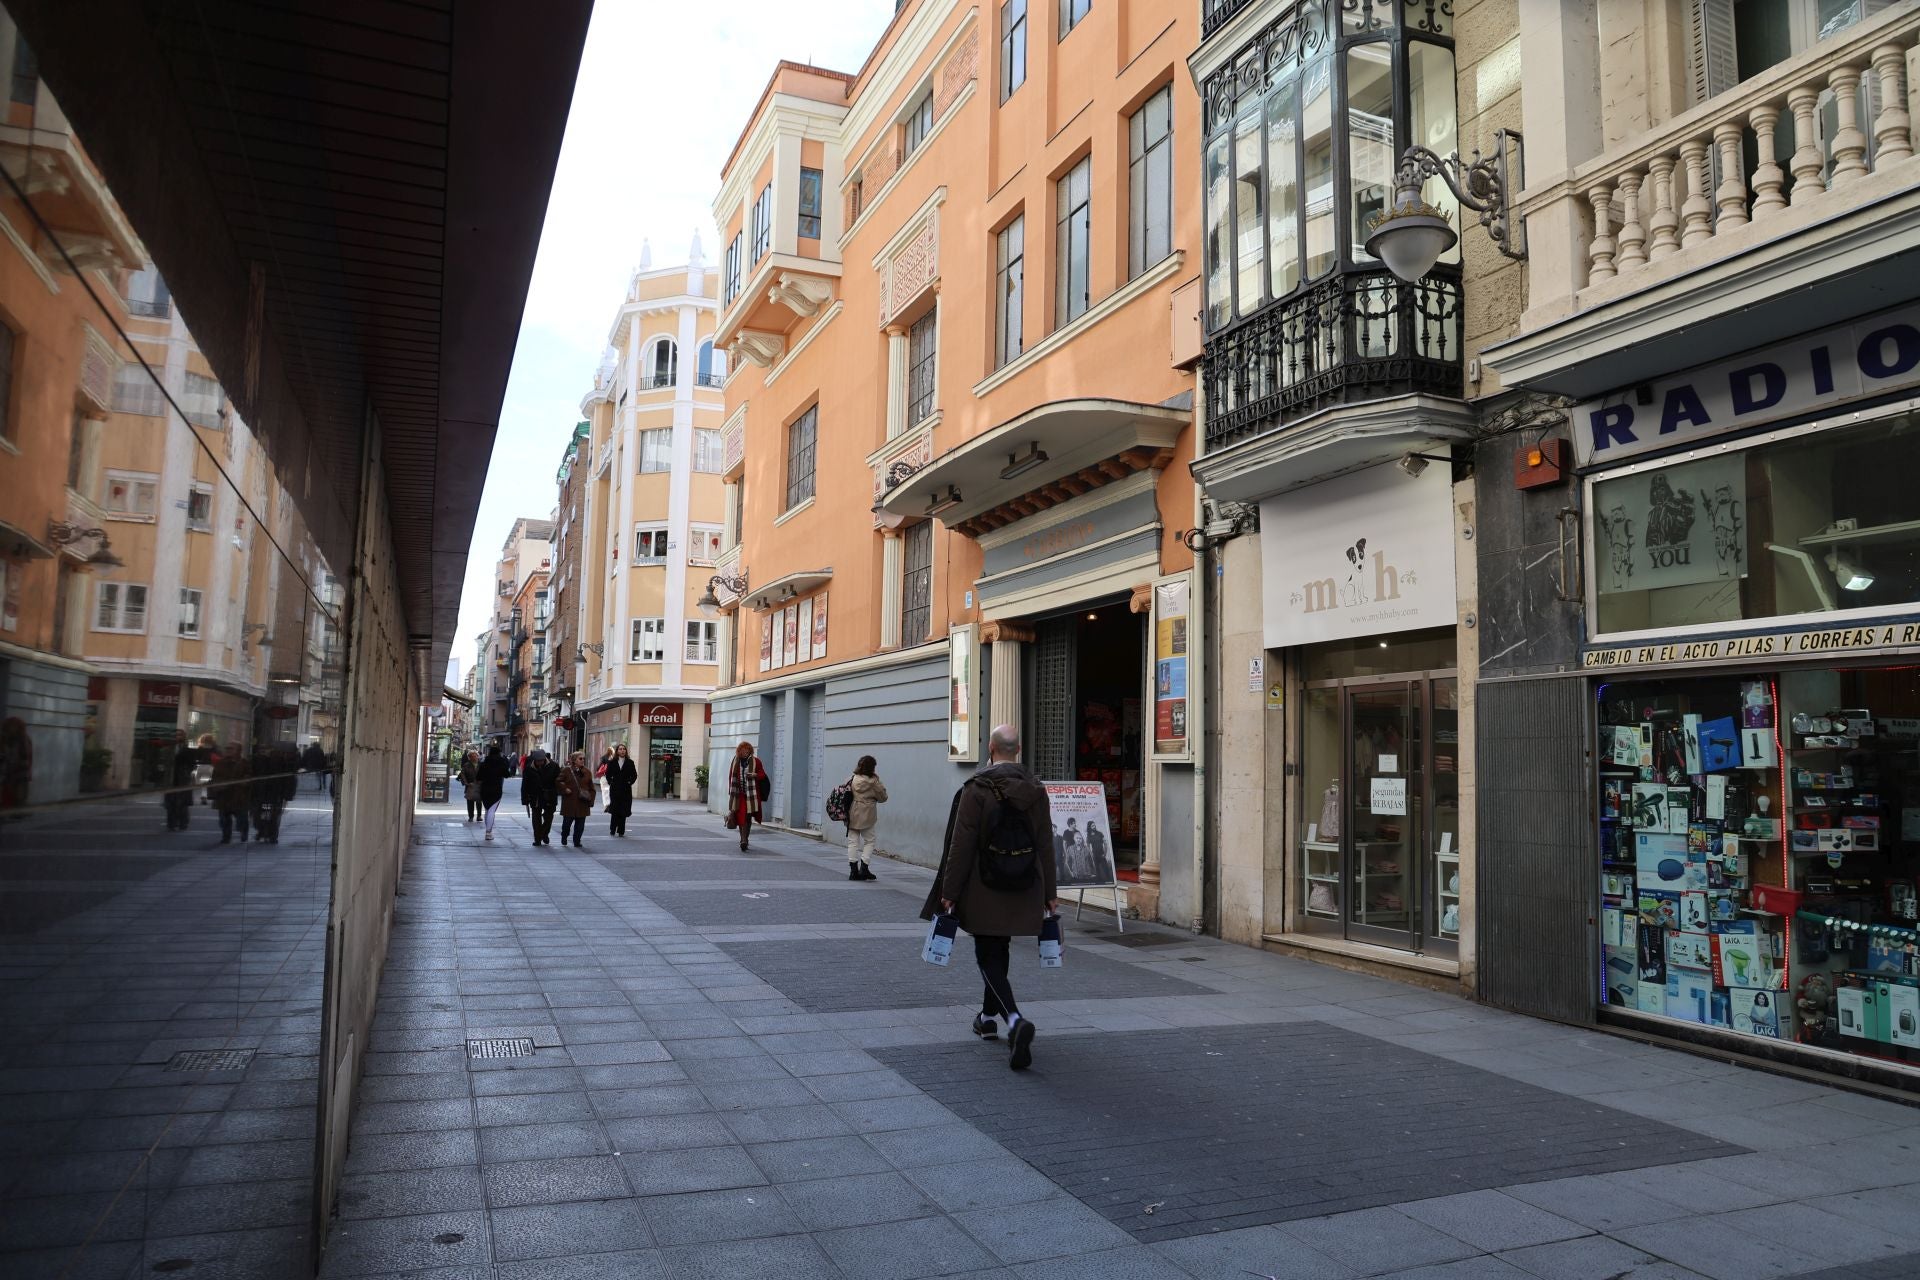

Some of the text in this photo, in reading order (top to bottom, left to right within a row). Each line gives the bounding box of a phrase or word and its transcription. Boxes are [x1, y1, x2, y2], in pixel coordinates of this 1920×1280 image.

[1590, 324, 1920, 450] RADIO
[1649, 546, 1691, 569] YOU
[1586, 650, 1631, 665] CAMBIO
[1638, 648, 1655, 662] EN
[1660, 647, 1675, 661] EL
[1683, 642, 1719, 660] ACTO
[1726, 637, 1774, 656] PILAS
[1783, 635, 1793, 651] Y
[1800, 628, 1875, 650] CORREAS
[1882, 627, 1893, 644] A
[642, 712, 677, 723] arenal
[1046, 785, 1099, 795] ESPISTAOS
